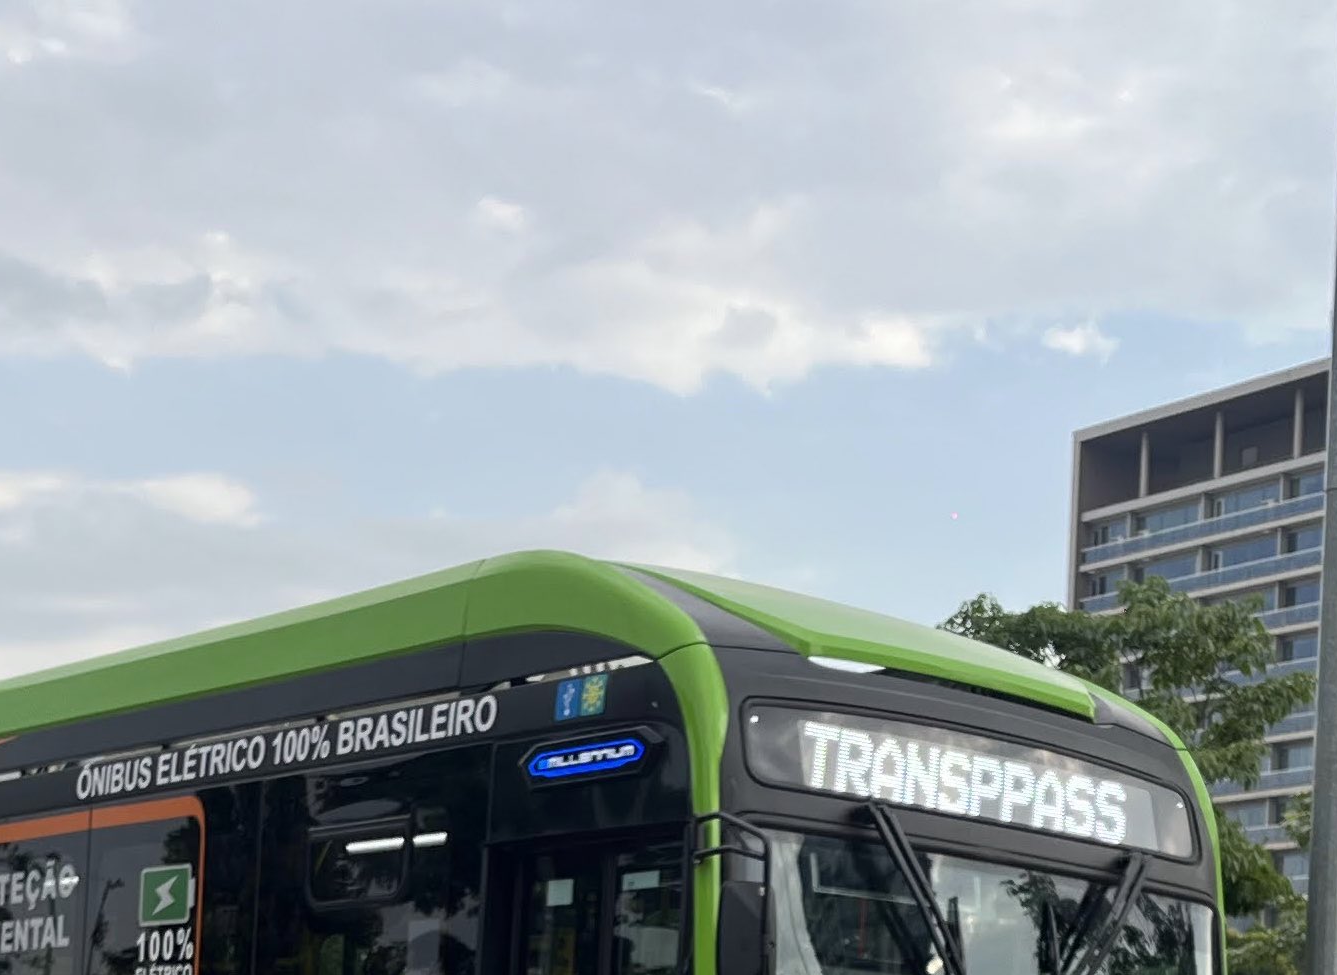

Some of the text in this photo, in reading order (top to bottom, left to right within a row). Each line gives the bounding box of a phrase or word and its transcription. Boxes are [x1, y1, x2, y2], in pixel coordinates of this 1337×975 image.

[156, 734, 266, 787] ELÉTRICO
[272, 723, 331, 766] 100%
[337, 695, 498, 757] BRASILEIRO
[804, 720, 1127, 845] TRANSPPASS
[136, 927, 193, 963] 100%
